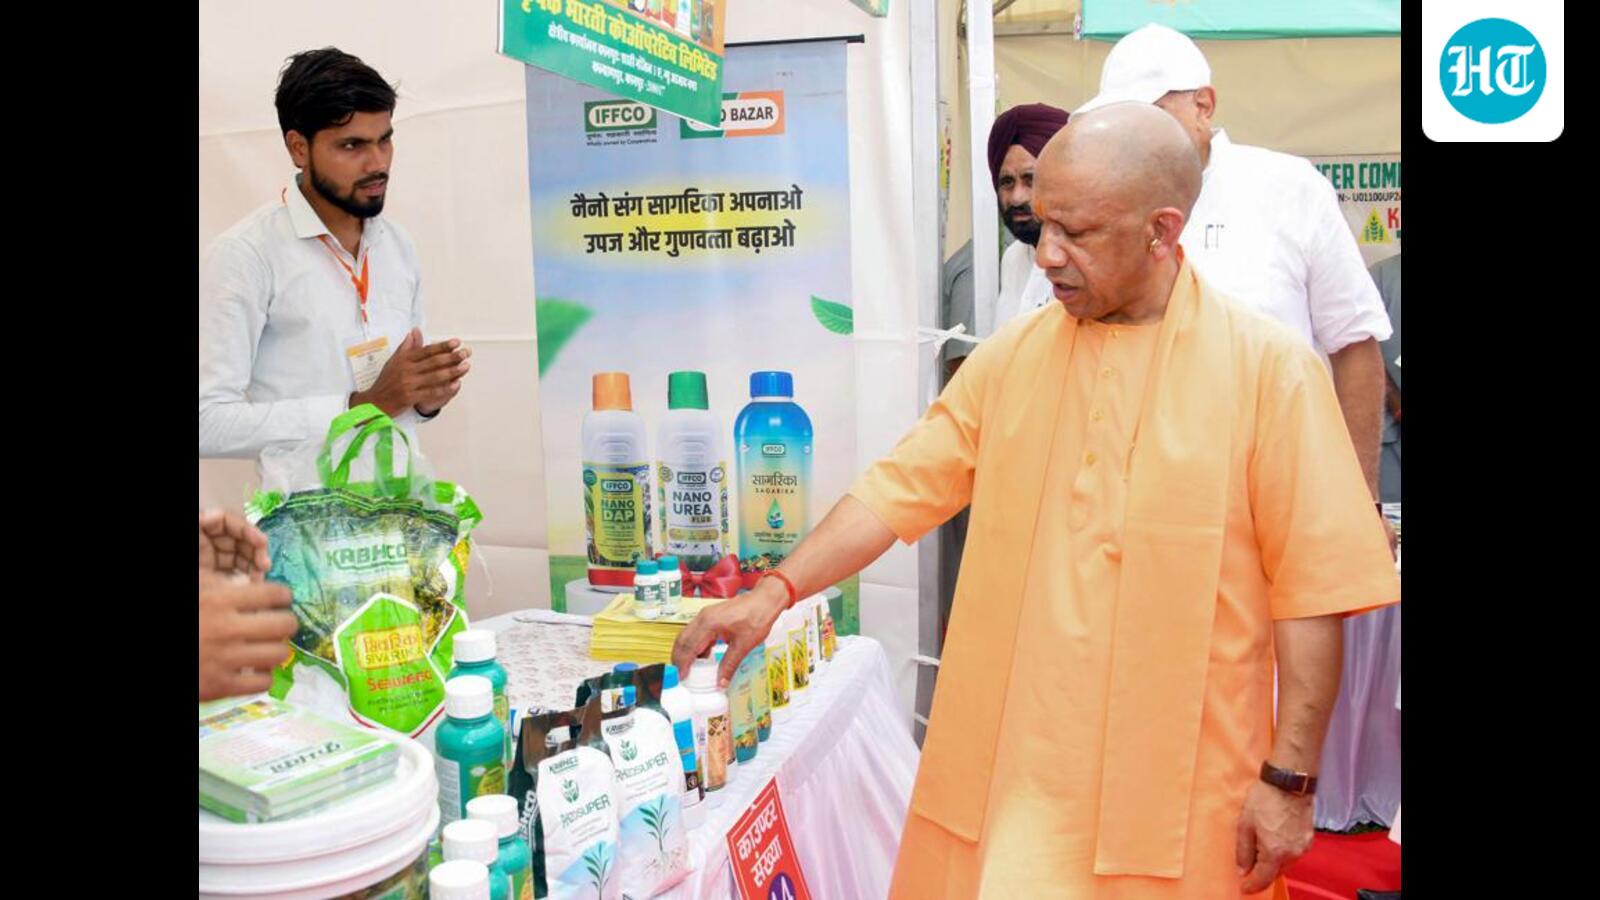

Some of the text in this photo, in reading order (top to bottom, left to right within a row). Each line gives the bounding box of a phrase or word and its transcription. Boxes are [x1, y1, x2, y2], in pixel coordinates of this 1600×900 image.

[566, 0, 606, 35] भारती
[679, 47, 718, 81] लिमिटेड
[595, 106, 646, 124] IFFCO
[730, 106, 774, 122] BAZAR
[1359, 162, 1401, 188] COM
[570, 184, 803, 219] नैनो संग सागरिका अपनाओ
[1352, 192, 1401, 202] U01100UP2
[584, 218, 796, 257] उपज और गुणवत्ता बढ़ाओ
[605, 482, 629, 490] IFFCO
[752, 471, 798, 487] सागरिका
[602, 499, 635, 509] NANO
[673, 491, 712, 502] NANO
[603, 510, 634, 521] DAP
[673, 503, 712, 516] UREA
